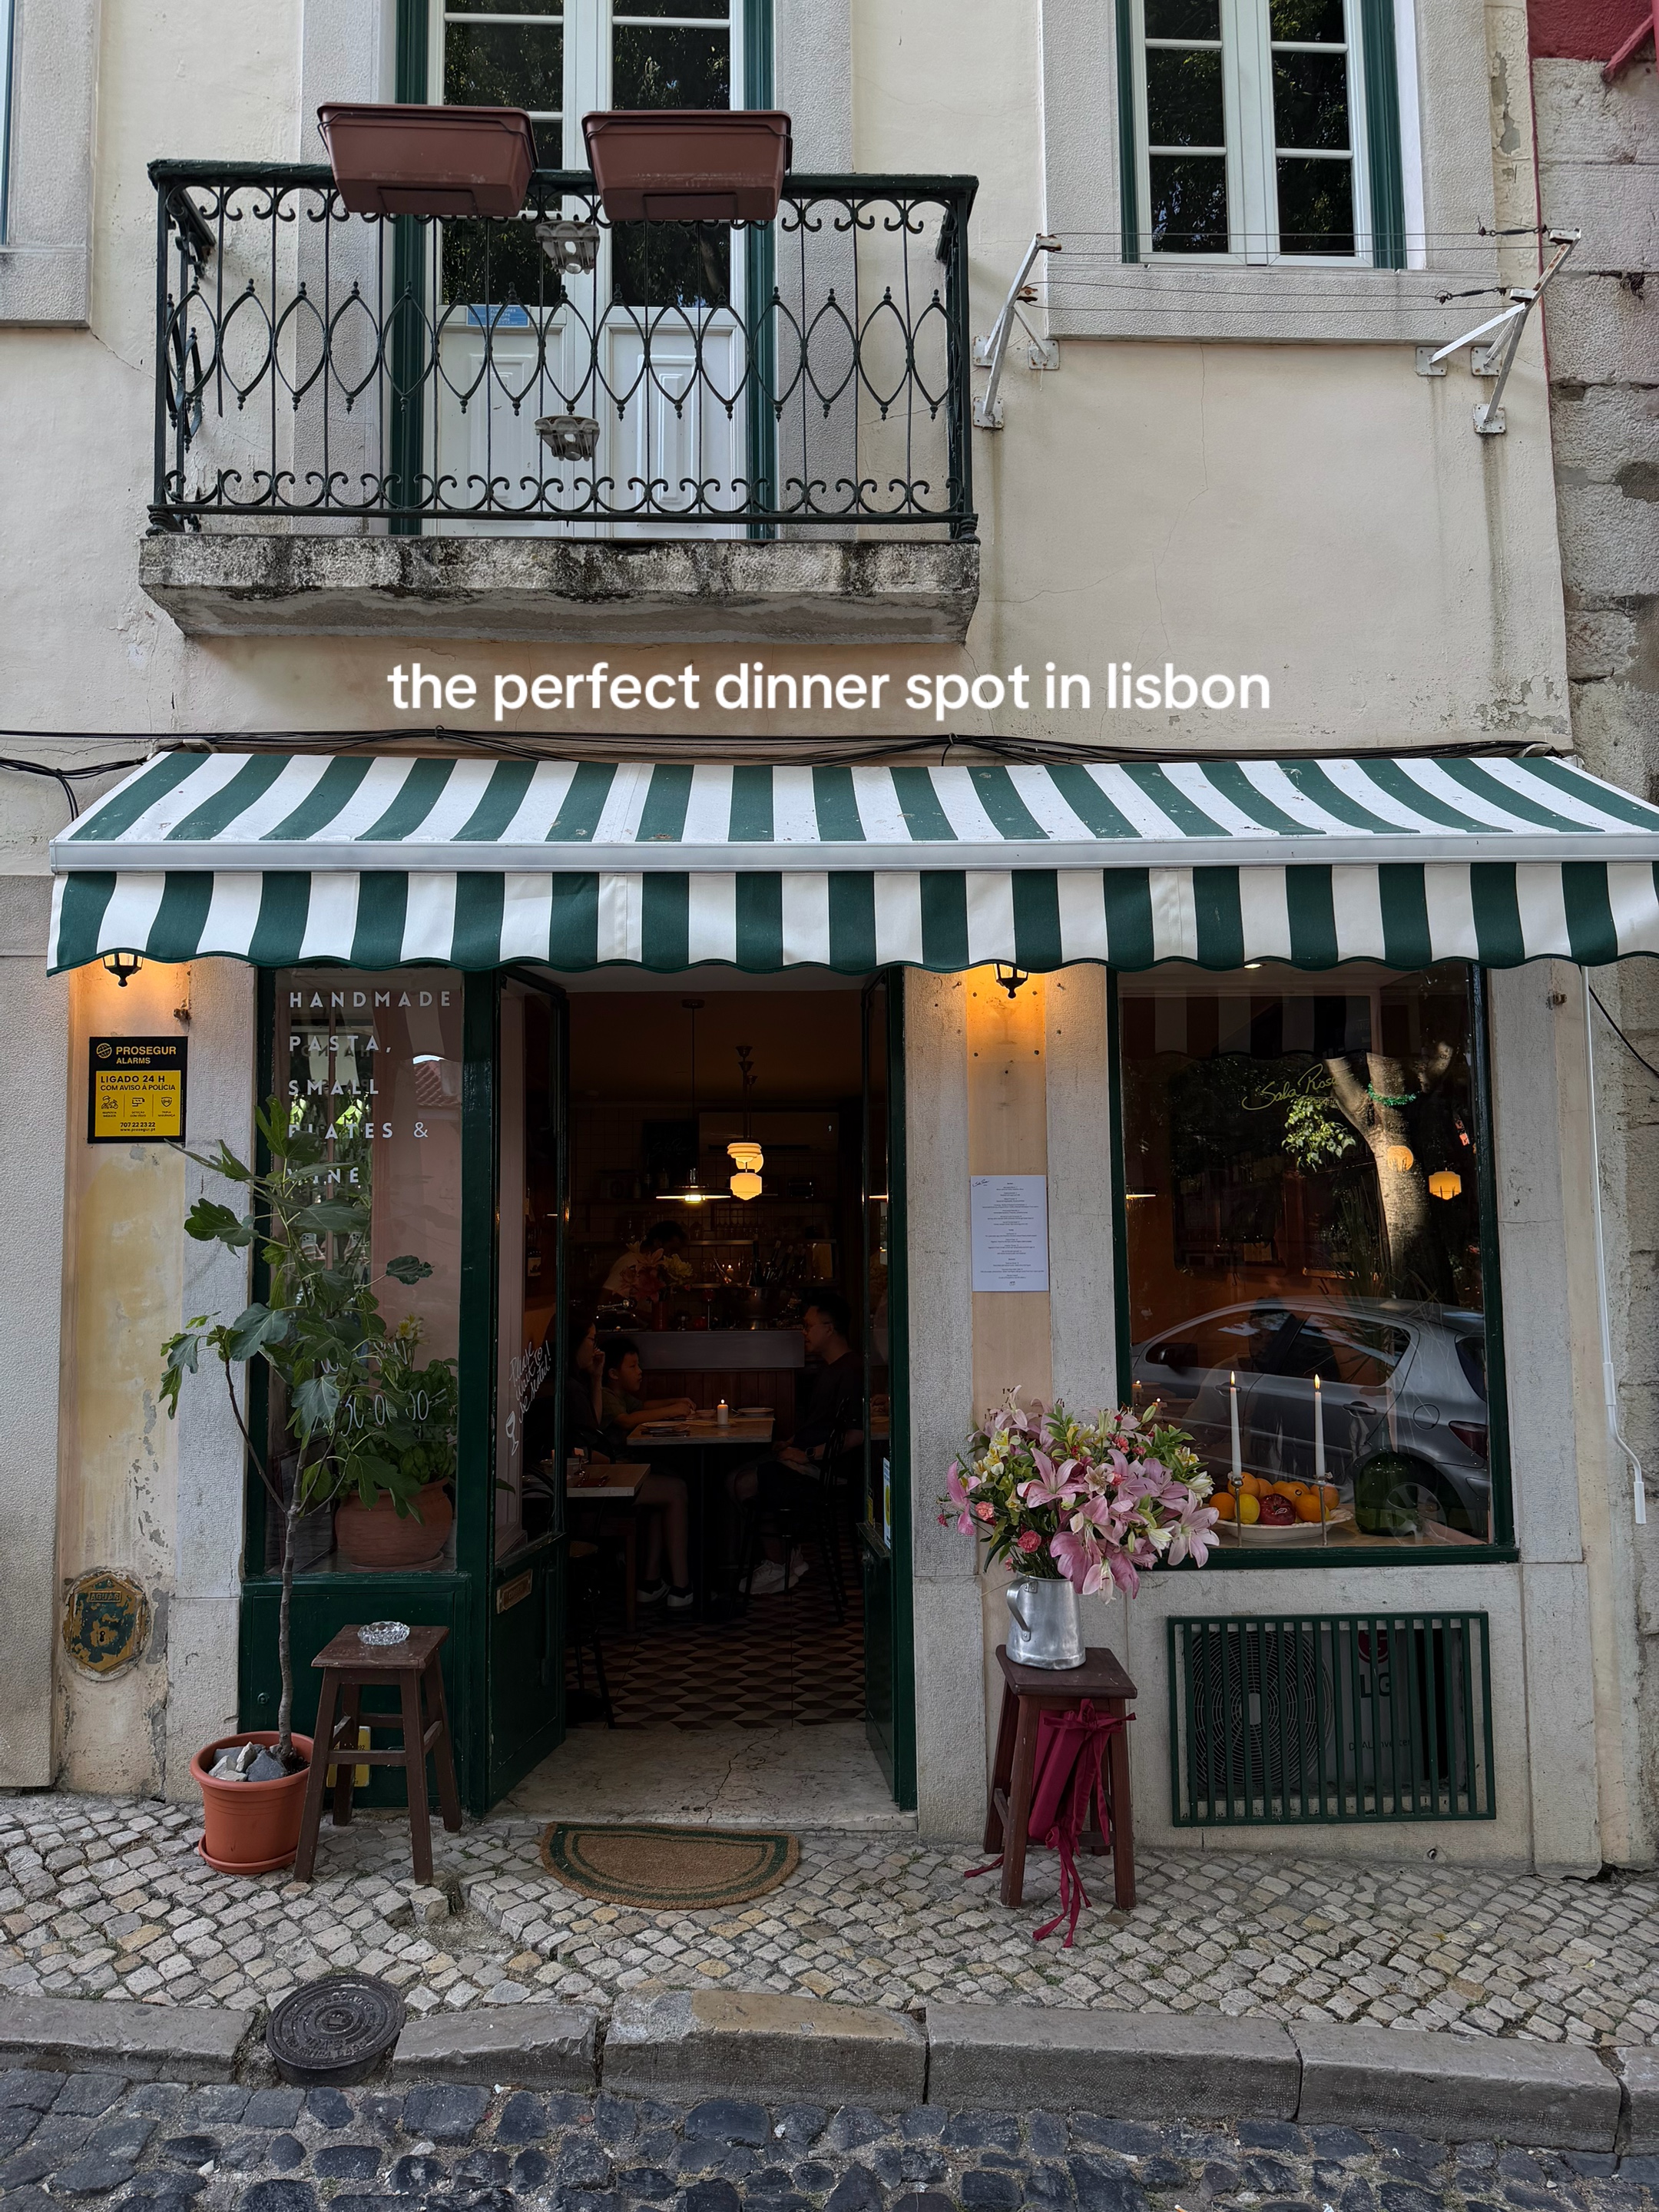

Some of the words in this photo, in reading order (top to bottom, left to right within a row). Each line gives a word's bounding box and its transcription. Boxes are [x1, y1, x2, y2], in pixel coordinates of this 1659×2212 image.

[290, 991, 450, 1008] HANDMADE
[116, 1046, 177, 1055] PROSEGUR
[290, 1035, 391, 1053] PASTA,
[288, 1078, 379, 1096] SMALL
[413, 1121, 429, 1138] &
[1359, 1673, 1391, 1698] LG
[1349, 1741, 1374, 1751] DAL
